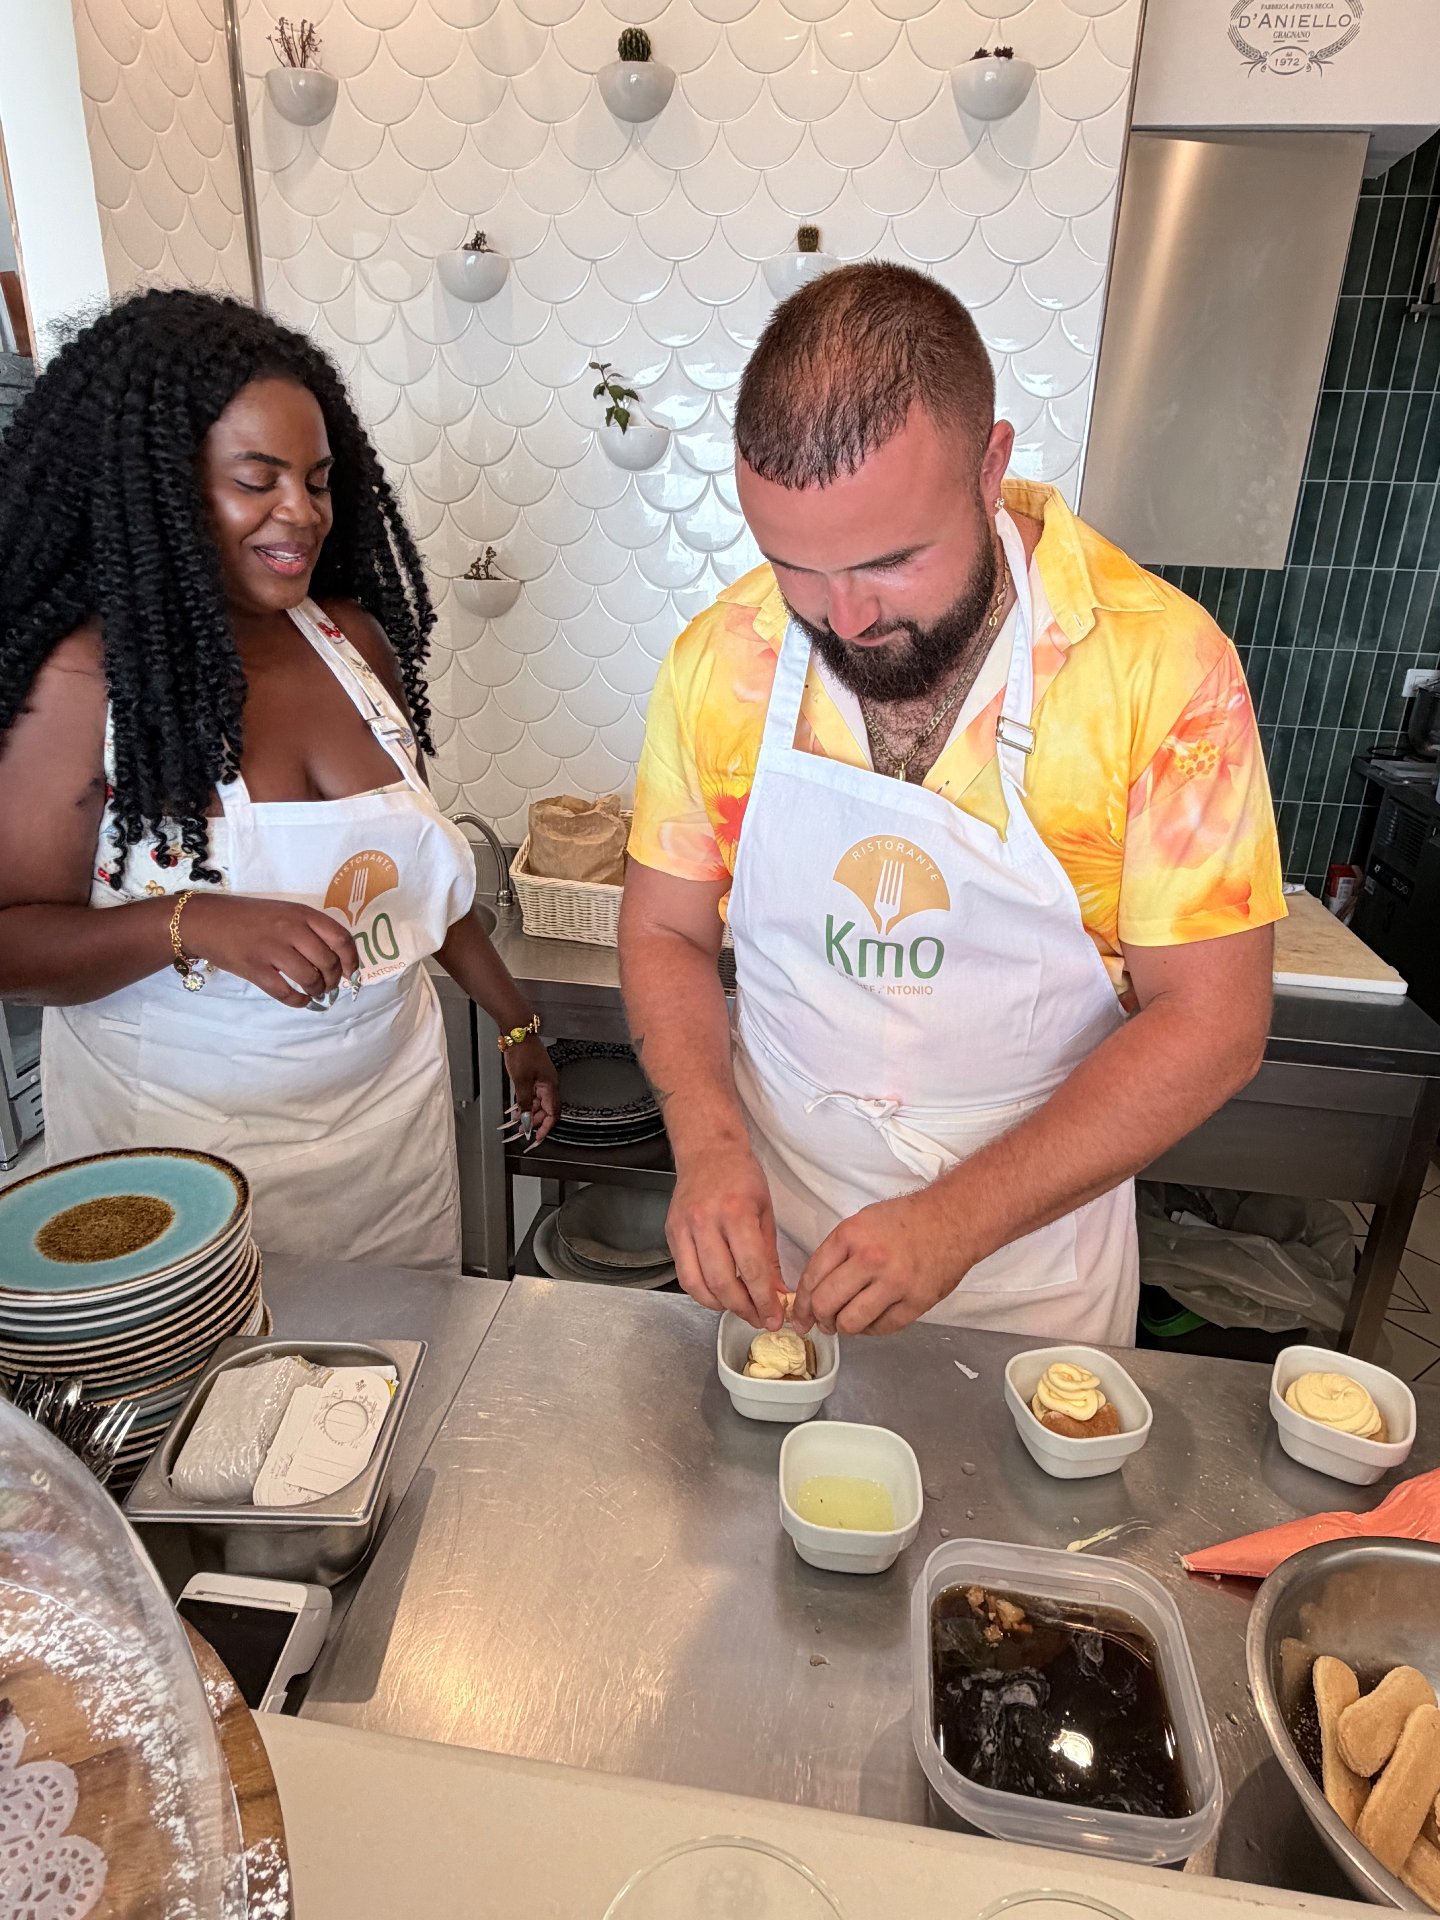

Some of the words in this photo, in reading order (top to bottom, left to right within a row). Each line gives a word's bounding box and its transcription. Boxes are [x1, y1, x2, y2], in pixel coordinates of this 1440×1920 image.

[1238, 13, 1353, 29] D'ANIELLO
[1273, 30, 1311, 39] GRAGNANO
[1275, 57, 1300, 66] 1972
[334, 853, 393, 885] RISTORANTE
[852, 840, 940, 881] RISTORANTE
[367, 962, 407, 980] ANTONIO
